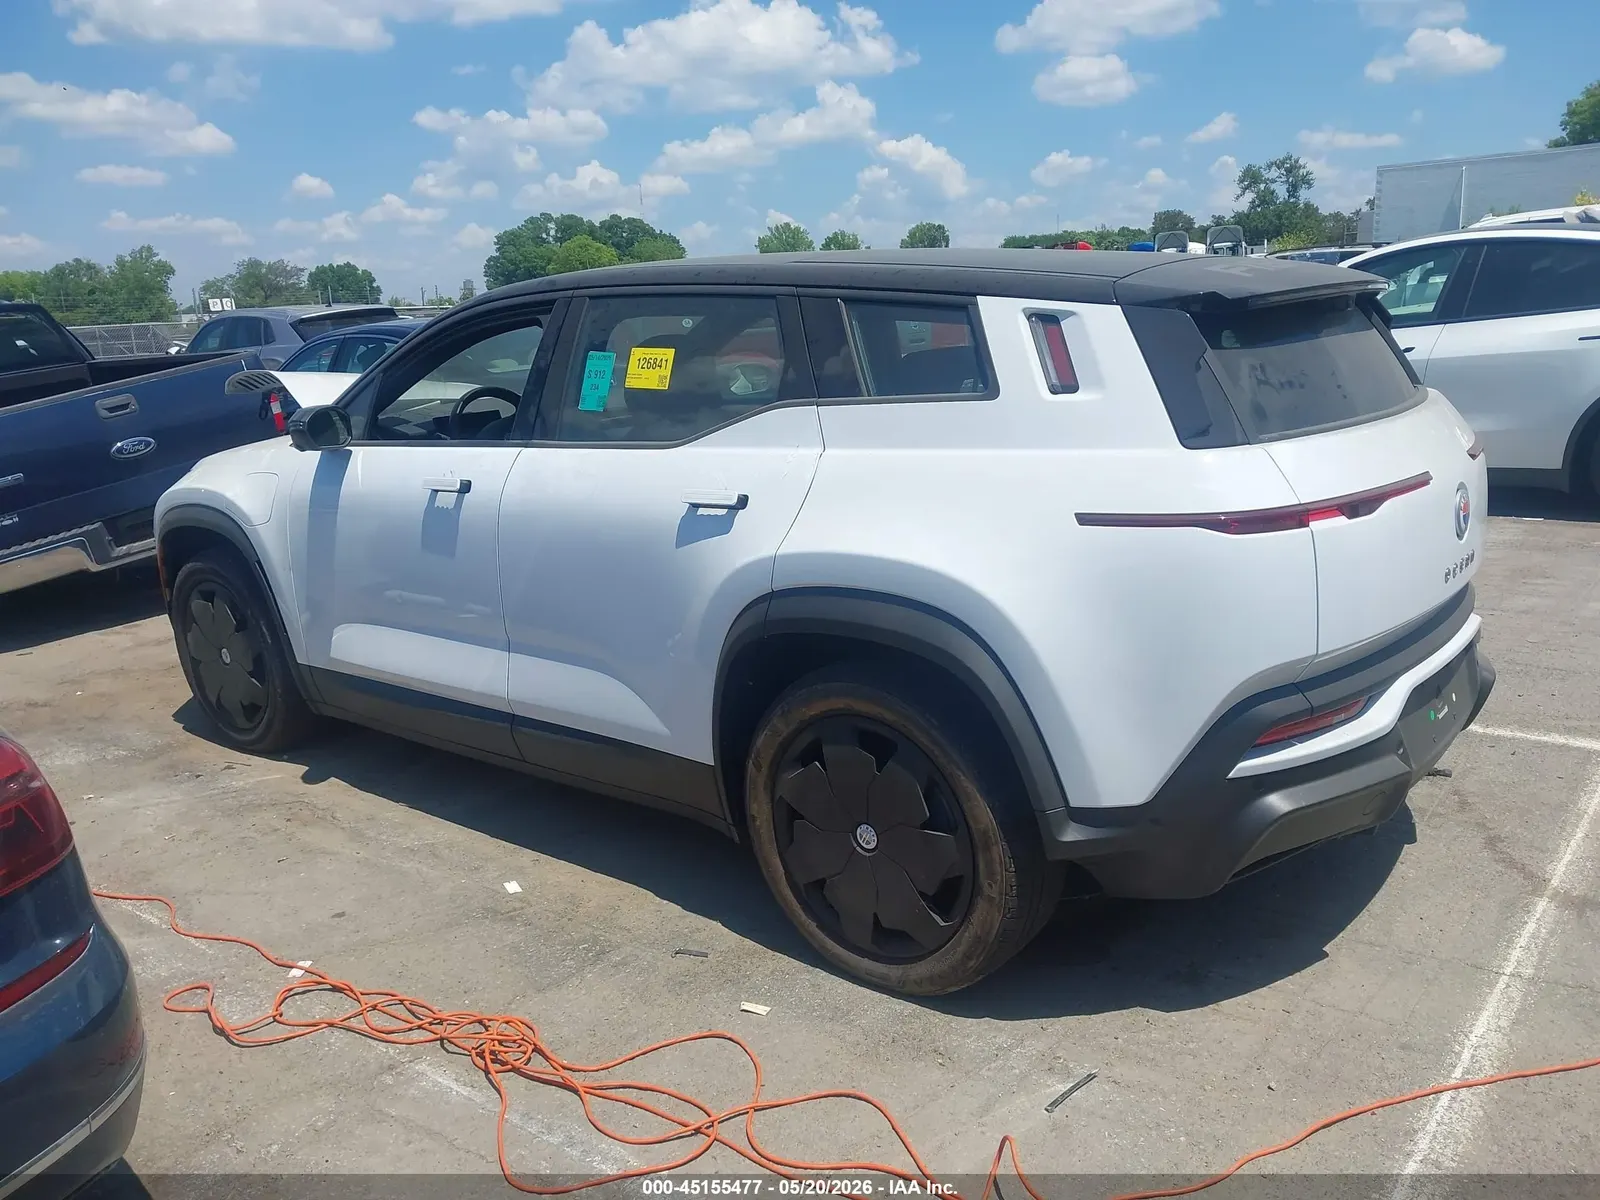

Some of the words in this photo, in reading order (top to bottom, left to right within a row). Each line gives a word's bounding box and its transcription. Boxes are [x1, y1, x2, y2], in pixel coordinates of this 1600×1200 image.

[637, 358, 669, 370] 126841
[594, 370, 606, 379] 912
[590, 383, 600, 391] 234
[123, 441, 145, 454] Ford
